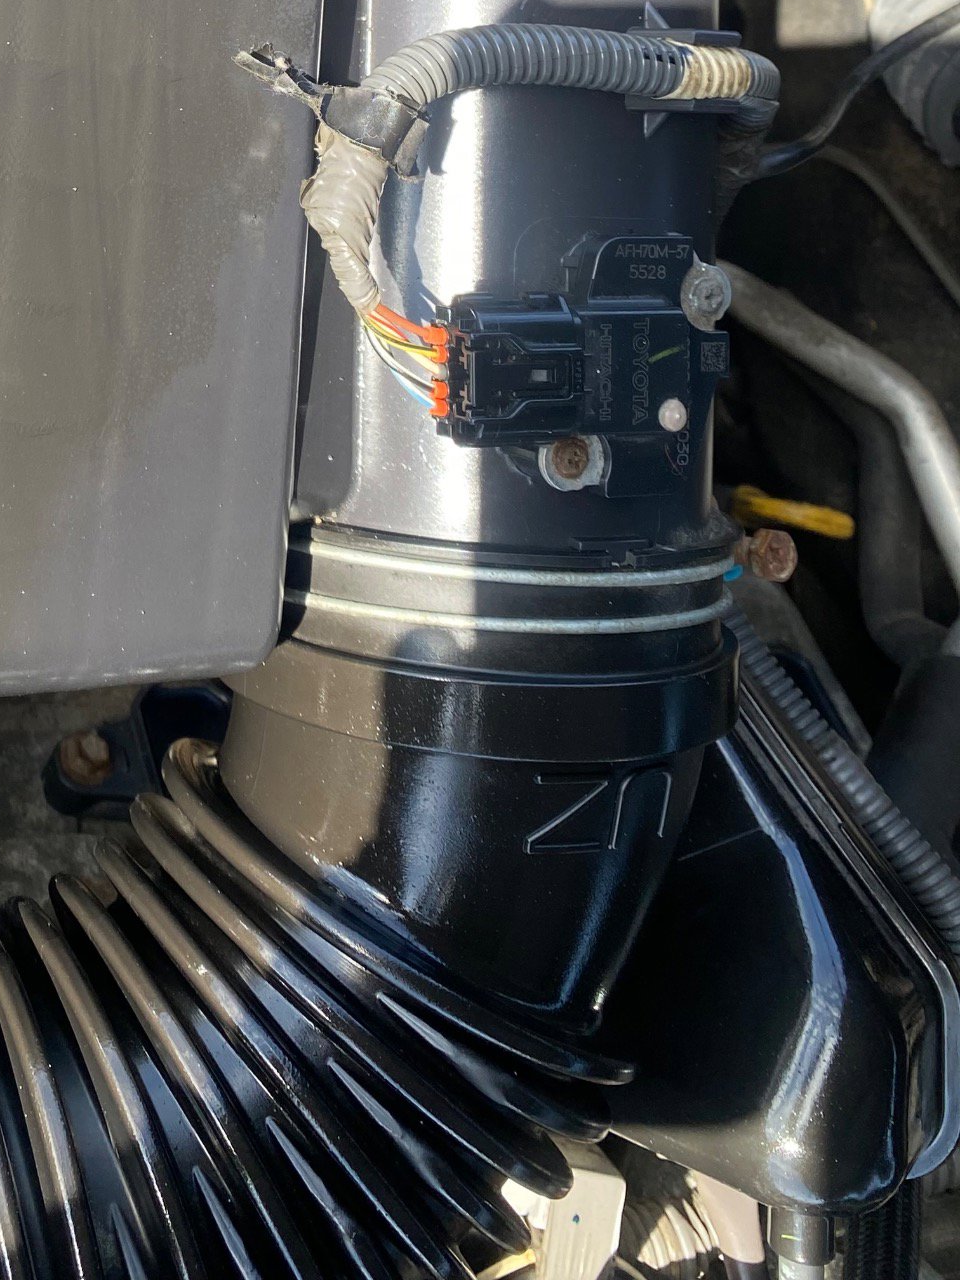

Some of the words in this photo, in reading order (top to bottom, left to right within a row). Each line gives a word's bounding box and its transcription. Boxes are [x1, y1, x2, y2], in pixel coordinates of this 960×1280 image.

[629, 264, 667, 280] 5528
[599, 322, 613, 421] HITACHI
[633, 317, 650, 426] TOYOTA
